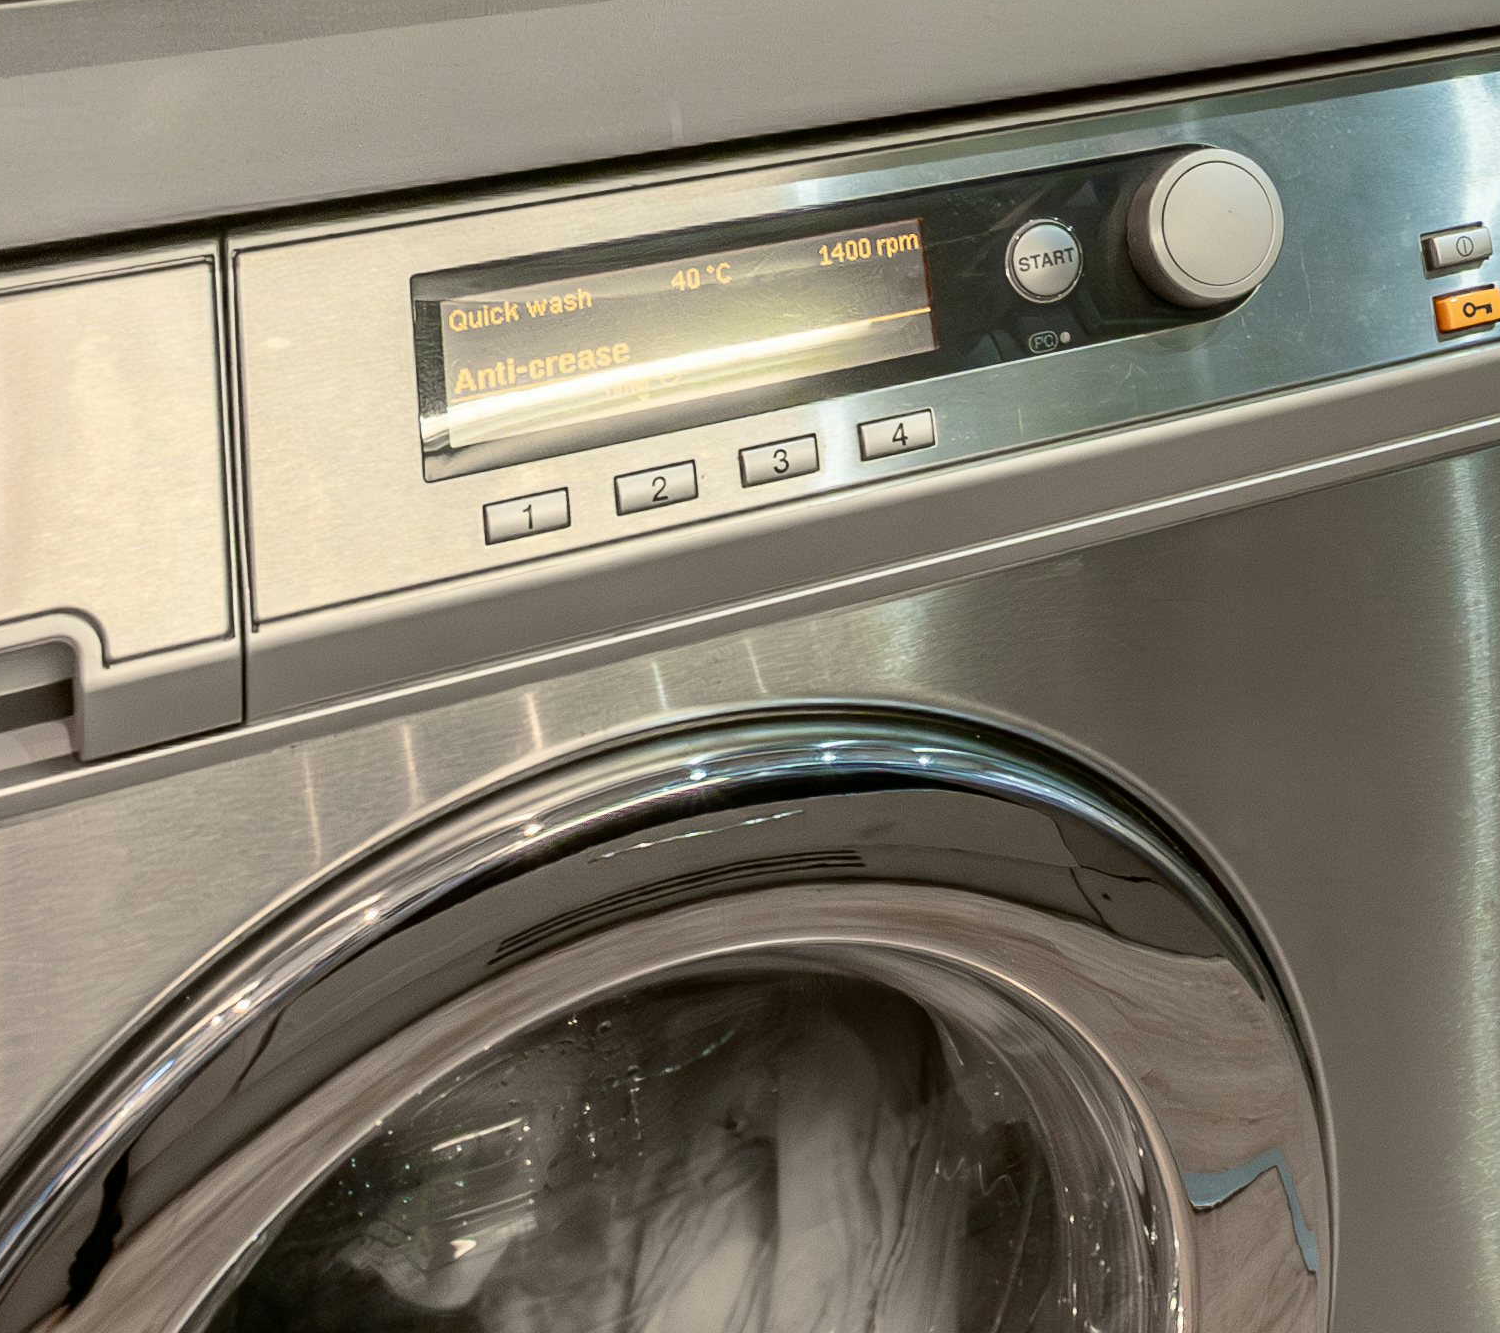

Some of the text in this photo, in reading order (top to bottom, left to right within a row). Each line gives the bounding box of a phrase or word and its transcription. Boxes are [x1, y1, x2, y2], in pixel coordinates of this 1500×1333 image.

[1018, 247, 1075, 272] START
[448, 232, 920, 332] Quick wash 40 °C 1400 rpm
[1034, 334, 1054, 349] PC
[454, 342, 630, 395] Anti-crease
[892, 422, 910, 447] 4
[773, 450, 790, 475] 3
[652, 477, 667, 503] 2
[523, 504, 535, 530] 1
